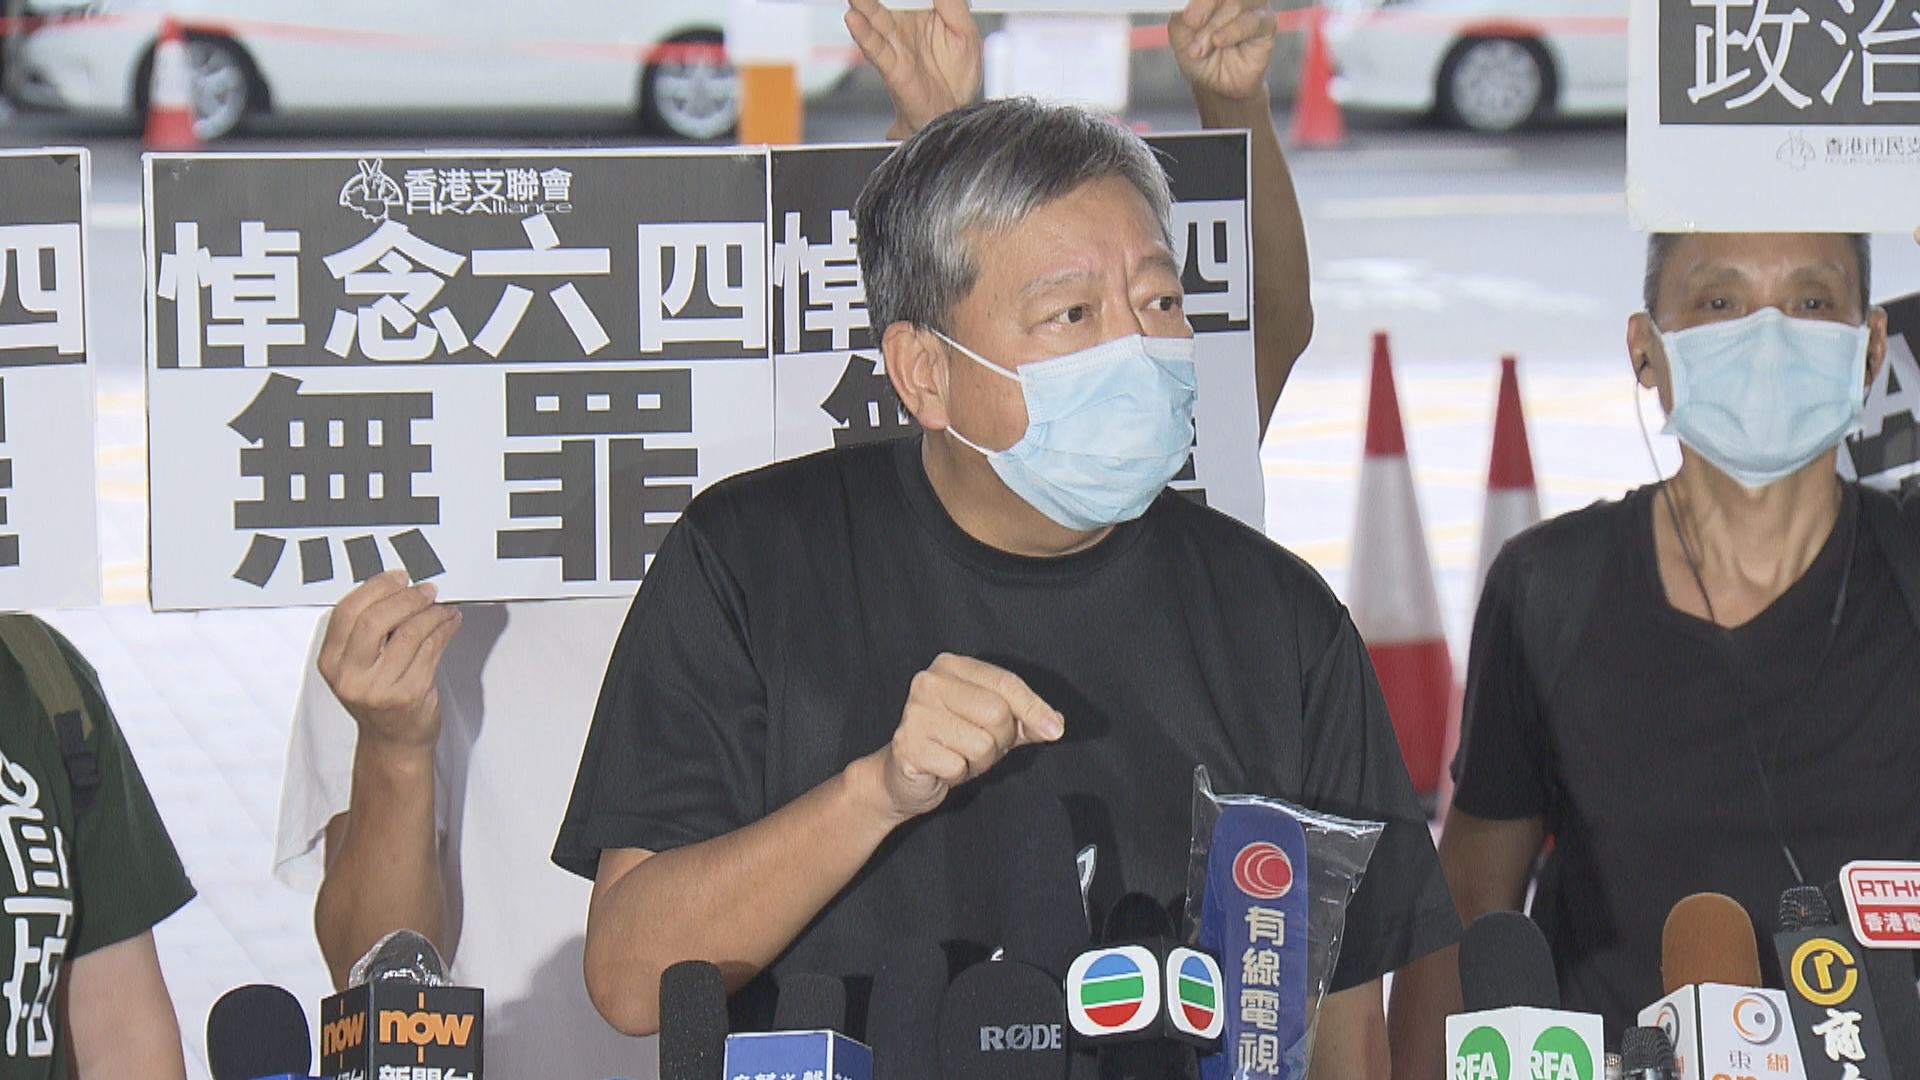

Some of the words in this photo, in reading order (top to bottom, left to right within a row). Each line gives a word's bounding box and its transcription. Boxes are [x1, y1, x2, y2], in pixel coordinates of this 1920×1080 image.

[1687, 0, 1920, 109] 政治
[404, 168, 573, 202] 香港支聯會
[157, 214, 768, 368] 悼念六四
[227, 368, 699, 588] 無罪
[1238, 905, 1286, 1076] 有線電視
[323, 1012, 365, 1056] now
[380, 1009, 474, 1047] now
[1455, 1051, 1499, 1080] RFA
[1529, 1050, 1581, 1080] RFA
